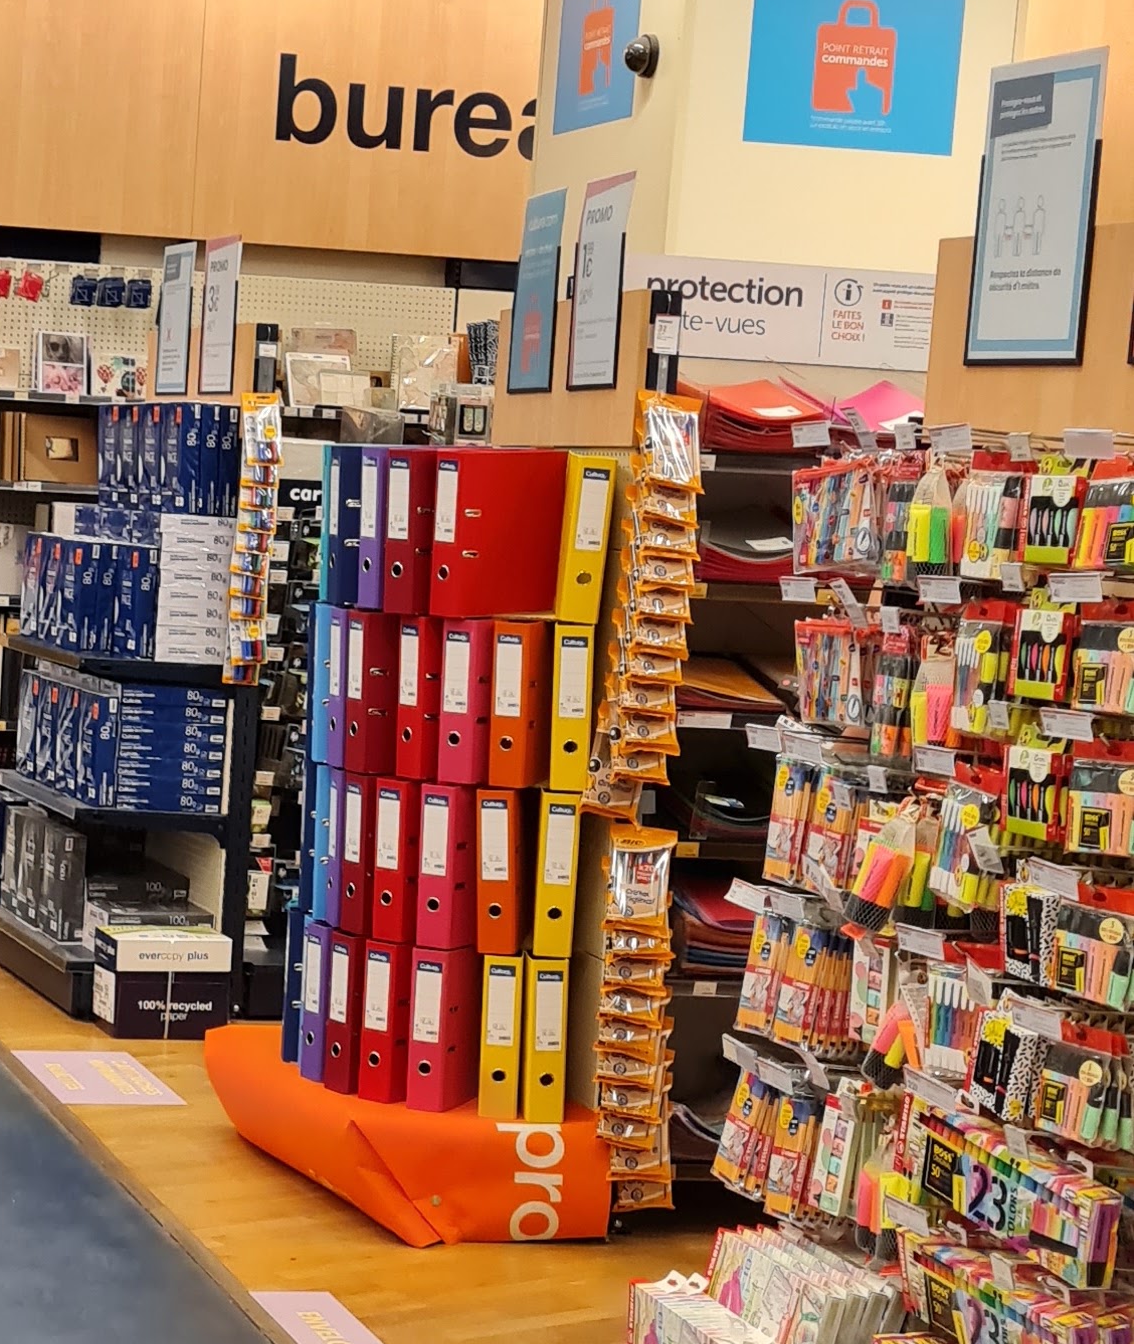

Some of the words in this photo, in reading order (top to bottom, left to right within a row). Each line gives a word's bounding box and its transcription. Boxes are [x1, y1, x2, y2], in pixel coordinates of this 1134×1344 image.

[823, 42, 851, 54] POINT
[853, 44, 890, 56] RETRAIT
[822, 54, 889, 67] commandes
[586, 205, 614, 227] PROMO
[833, 309, 862, 321] FAITES
[832, 321, 844, 330] LE
[845, 320, 864, 331] BON
[831, 331, 861, 341] CHOIX
[187, 951, 209, 962] plus
[138, 1000, 166, 1011] 100%
[168, 1000, 213, 1011] recycled
[933, 1144, 954, 1163] BOSS
